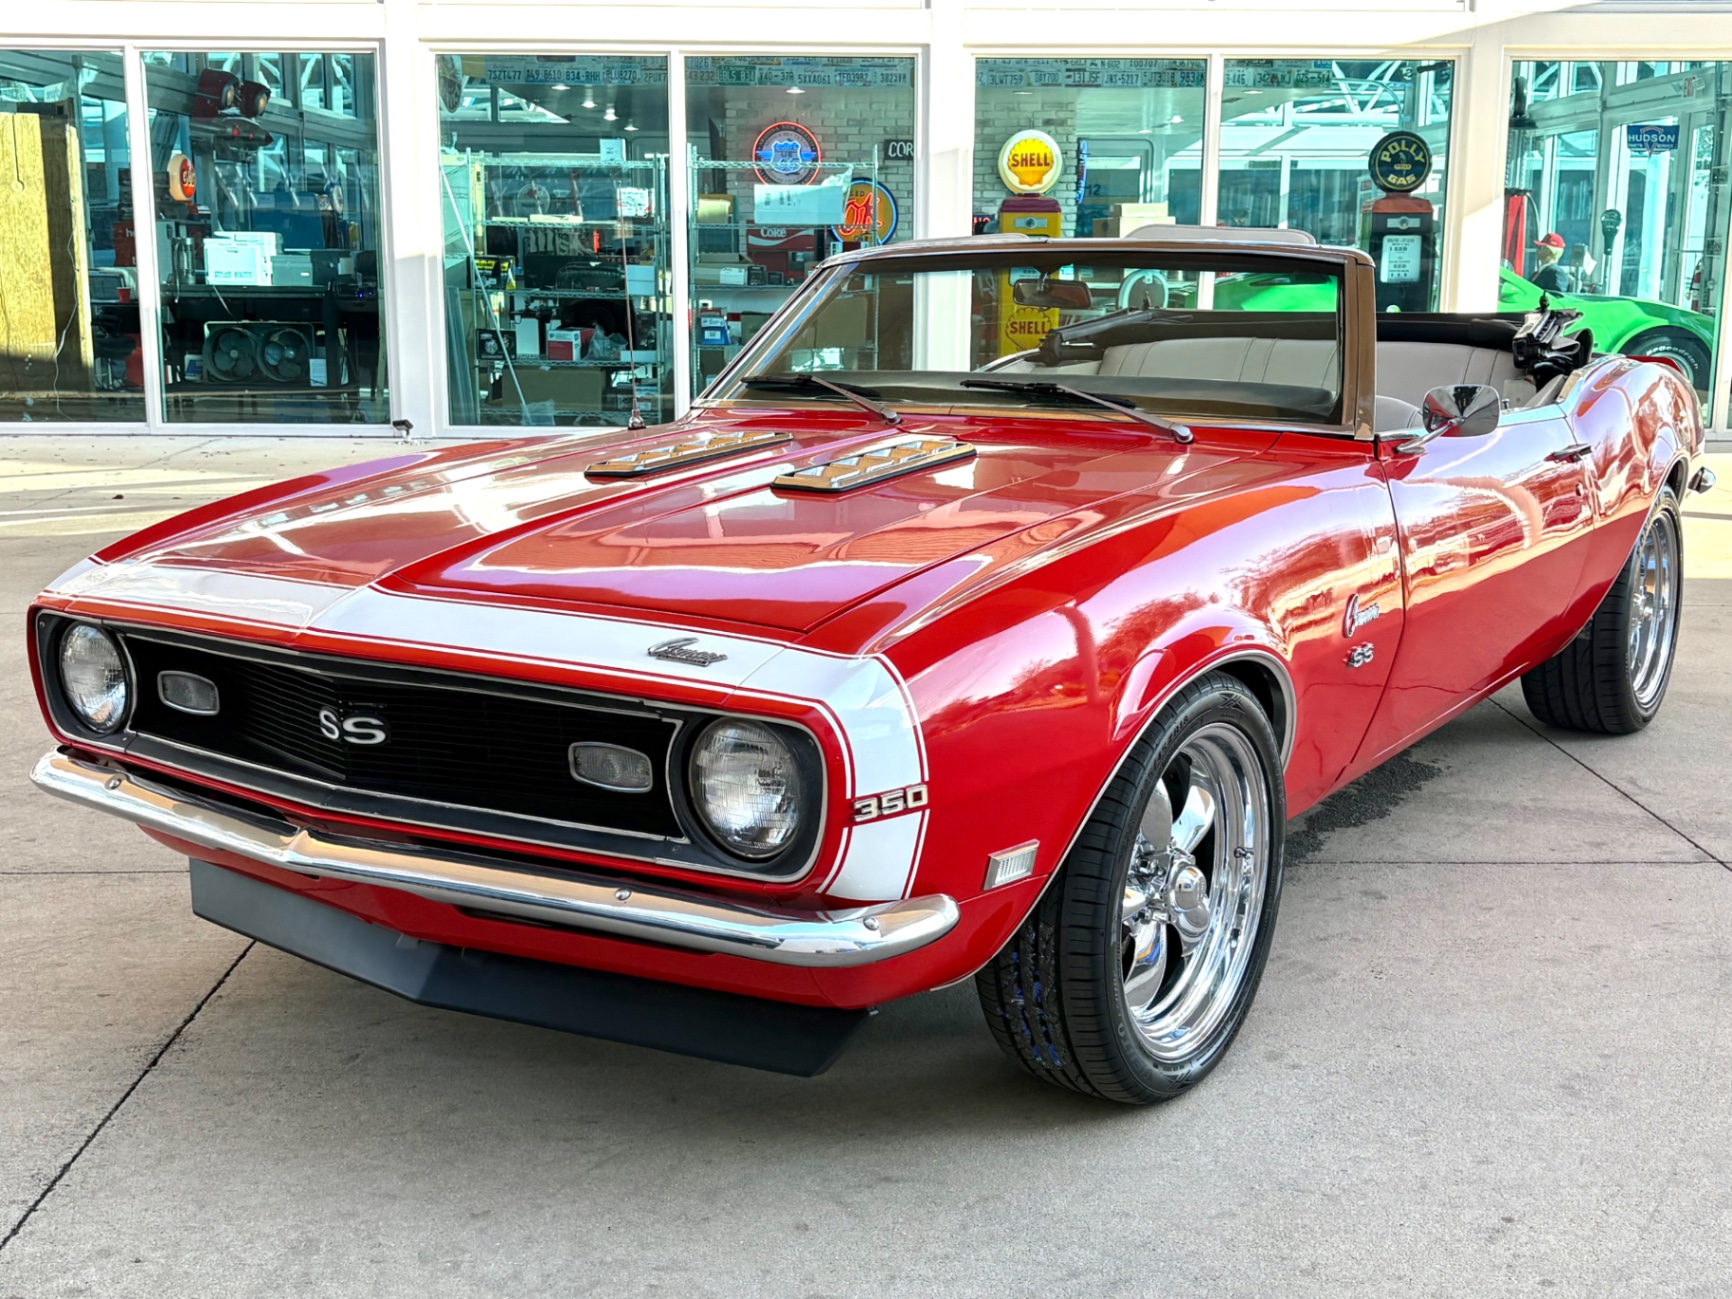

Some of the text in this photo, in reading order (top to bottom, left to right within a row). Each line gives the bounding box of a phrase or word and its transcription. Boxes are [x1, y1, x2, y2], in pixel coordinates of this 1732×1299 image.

[487, 69, 522, 81] 7SZT477
[1628, 133, 1676, 143] HUDSON
[1380, 140, 1425, 163] POLLY
[1011, 152, 1051, 168] SHELL
[1387, 173, 1417, 185] GAS
[760, 227, 787, 238] Coke
[1009, 321, 1049, 335] SHELL
[319, 705, 389, 745] SS
[853, 783, 929, 822] 350
